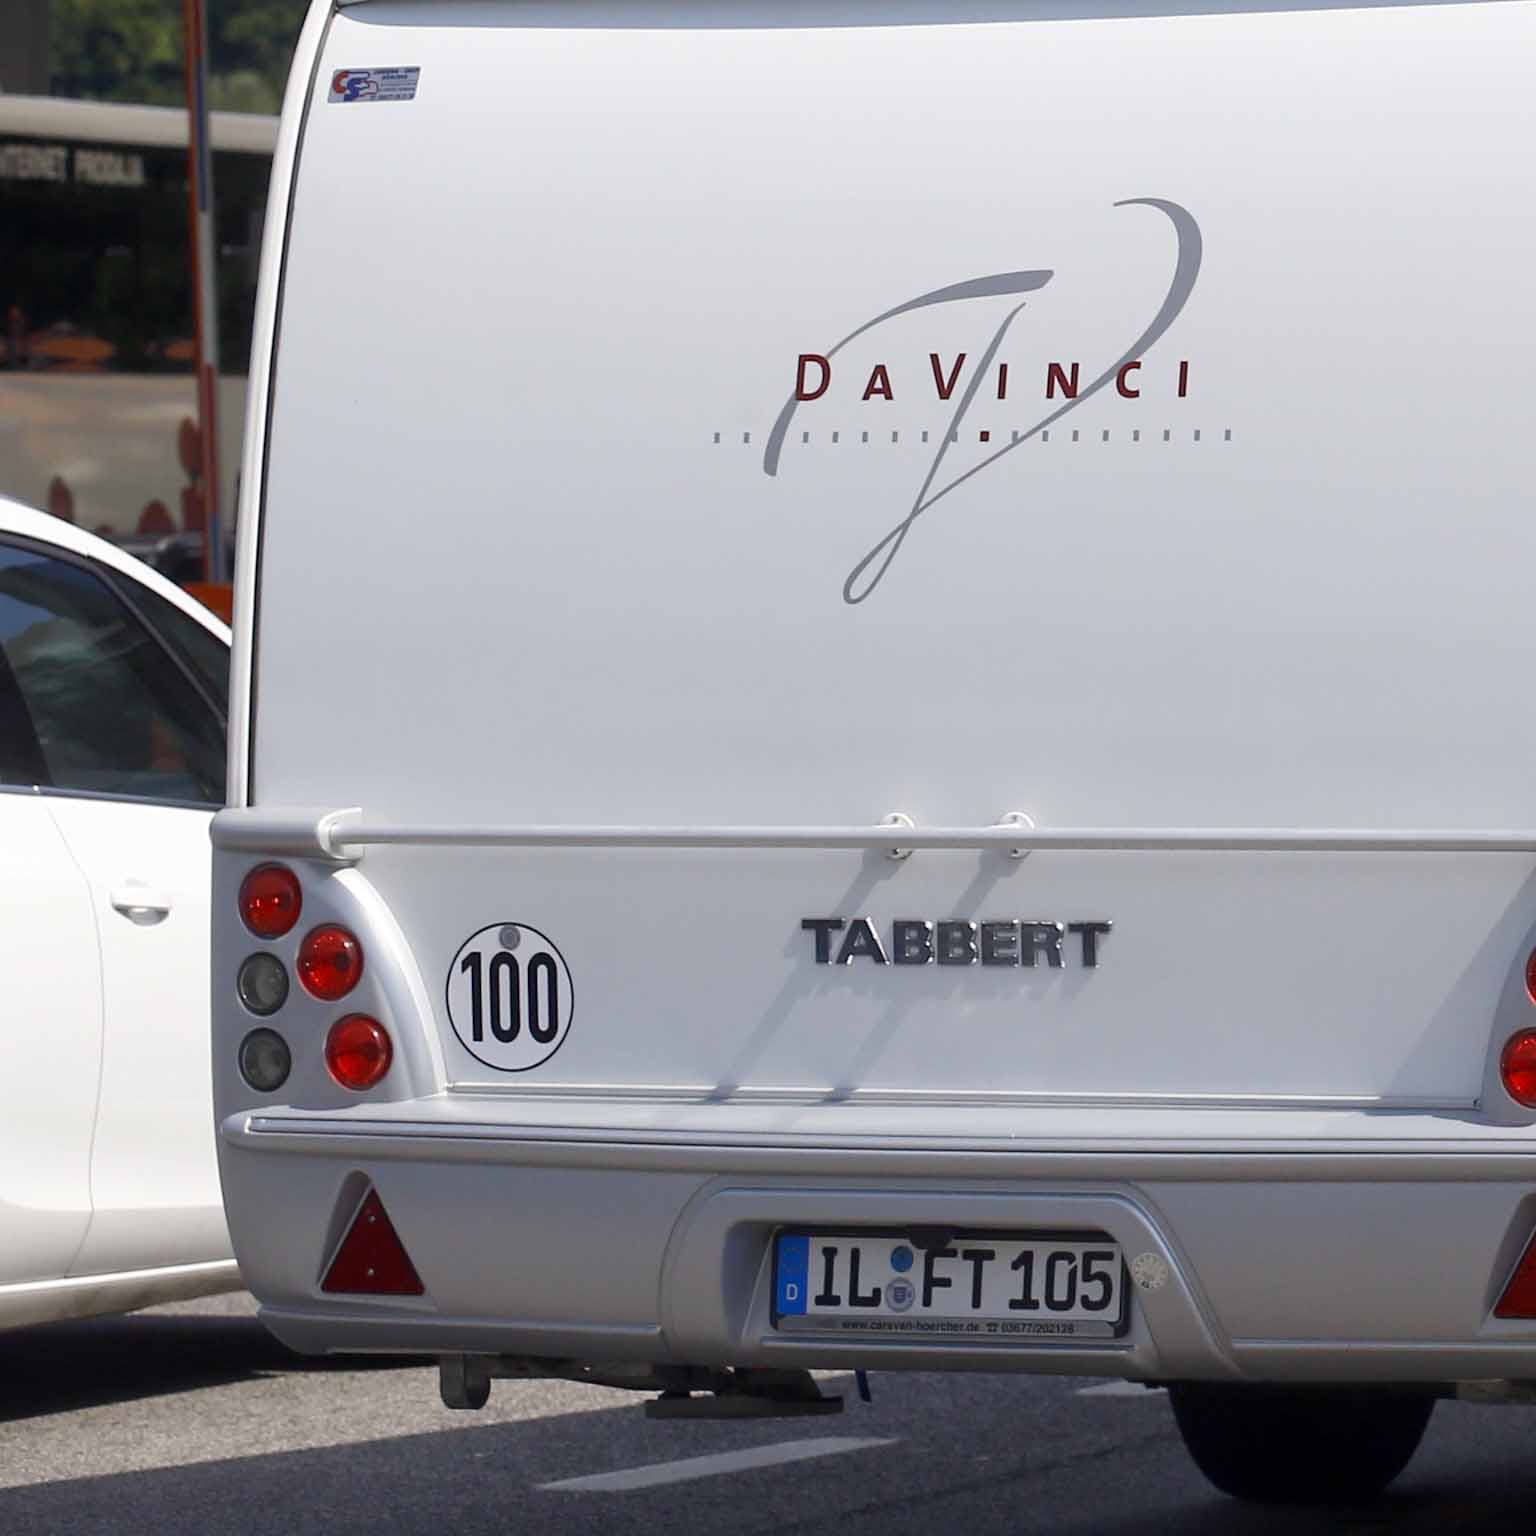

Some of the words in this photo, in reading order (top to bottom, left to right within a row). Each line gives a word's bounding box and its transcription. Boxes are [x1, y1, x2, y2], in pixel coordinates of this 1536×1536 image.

[801, 917, 1113, 968] TABBERT
[460, 950, 560, 1045] 100
[786, 1283, 799, 1301] D
[814, 1246, 882, 1308] IL
[921, 1248, 996, 1310] FT
[1008, 1250, 1114, 1312] 105
